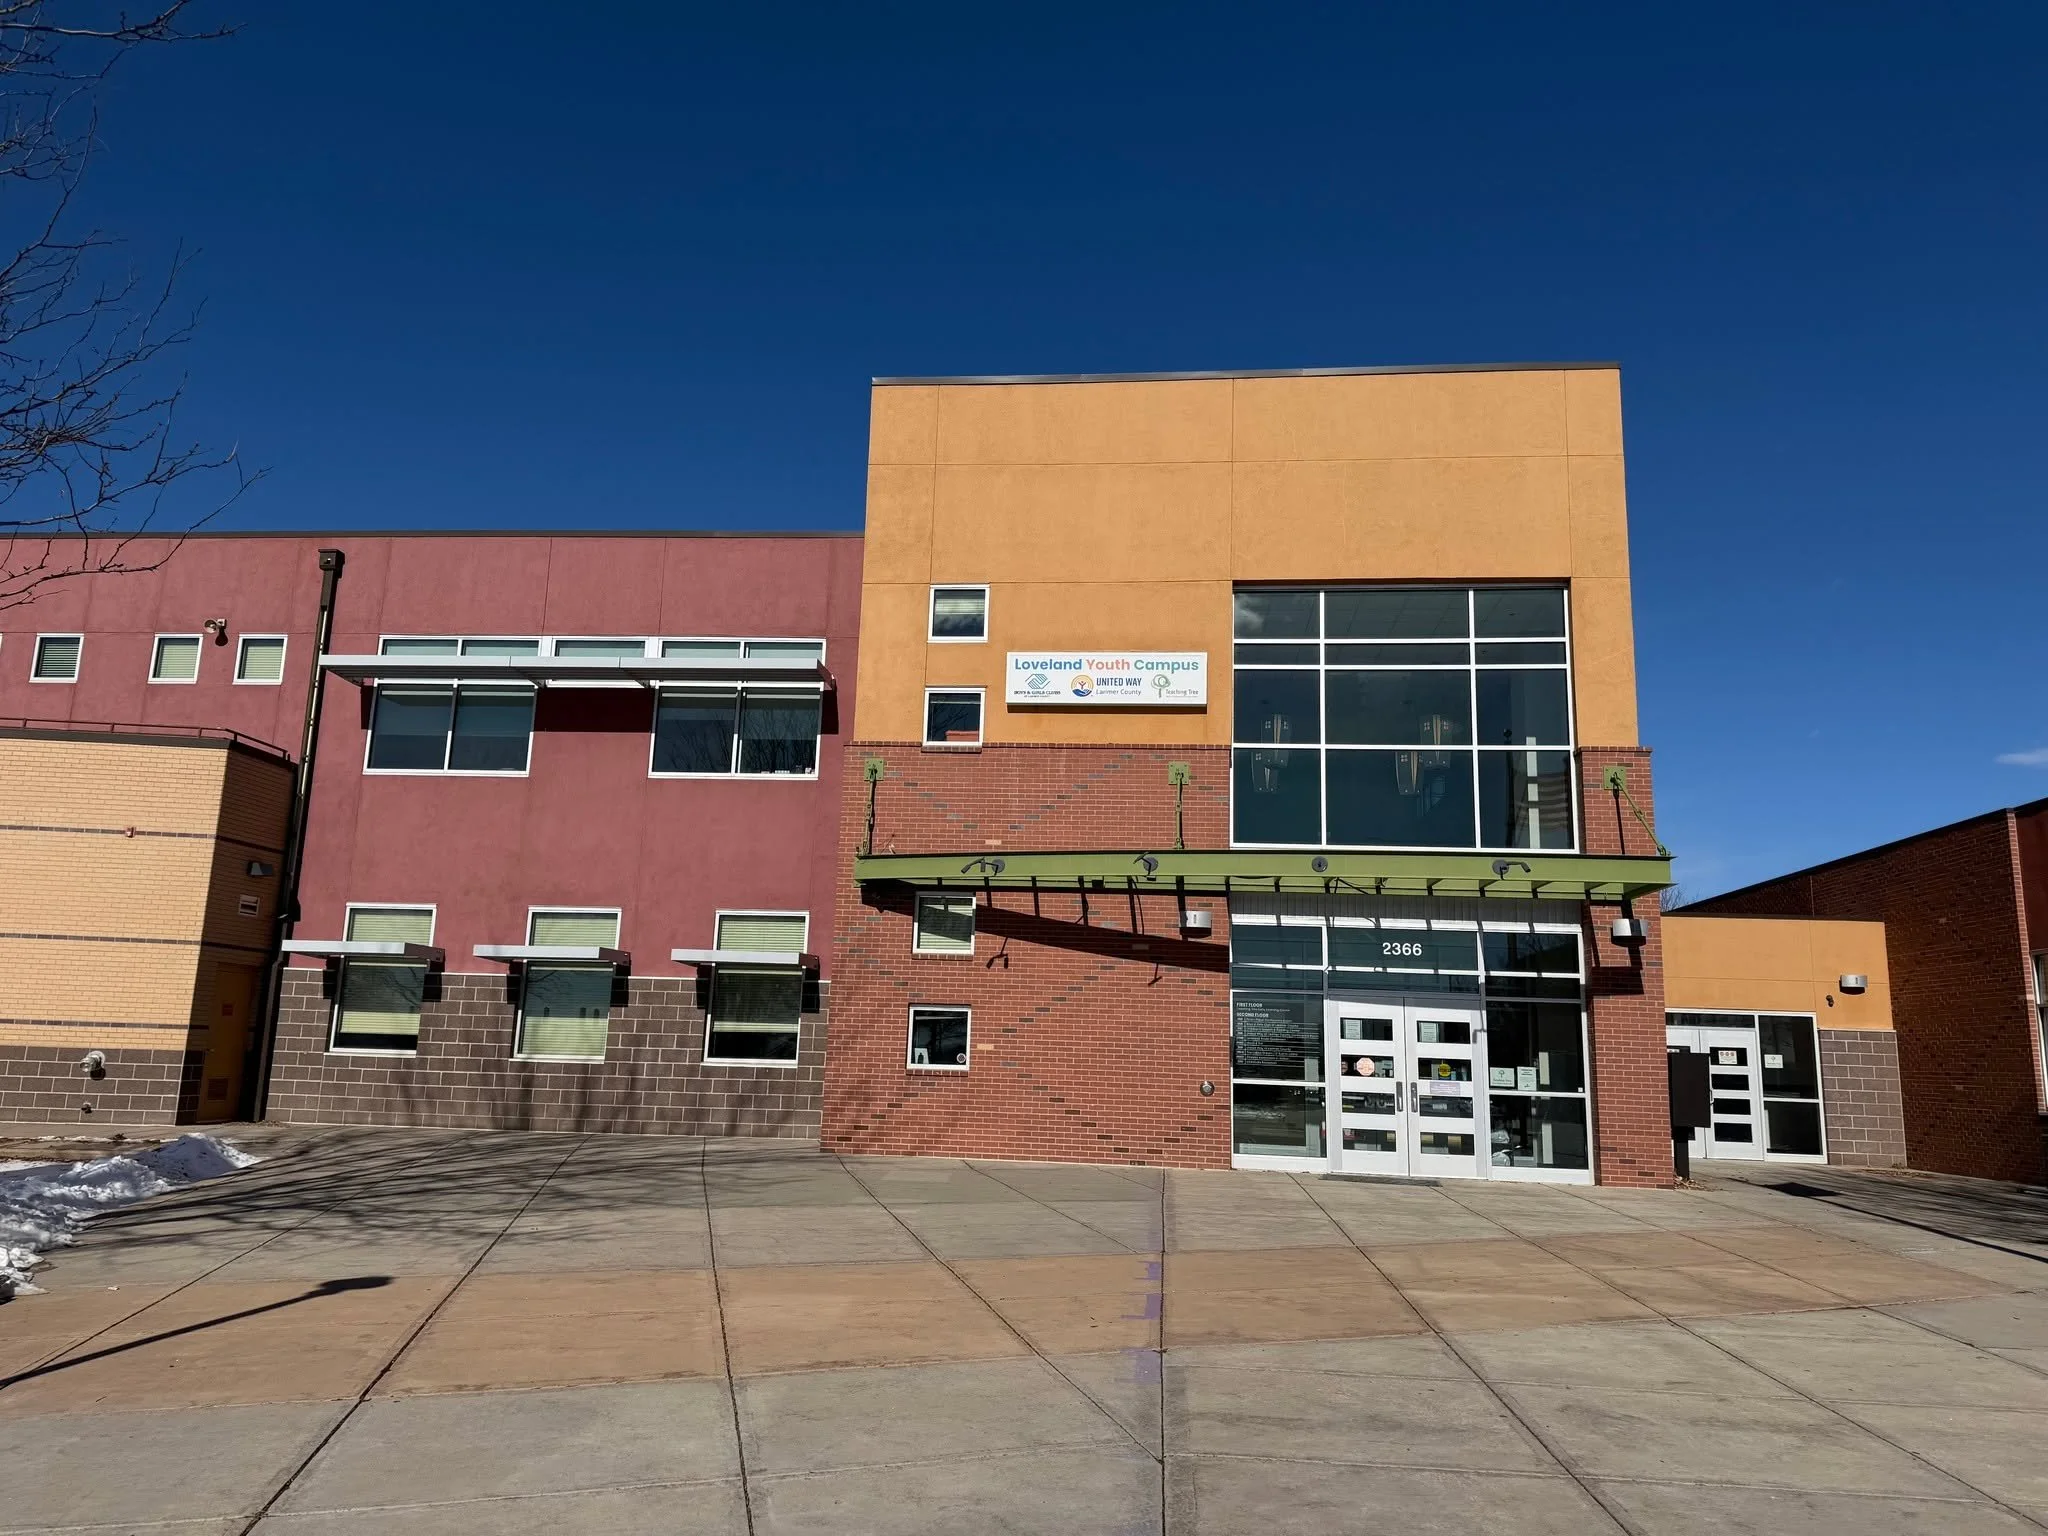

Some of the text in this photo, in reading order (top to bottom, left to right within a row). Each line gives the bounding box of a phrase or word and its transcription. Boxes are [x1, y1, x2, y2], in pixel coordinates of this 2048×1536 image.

[1015, 658, 1199, 674] Loveland Youth Campus
[1096, 677, 1142, 686] UNITED WAY
[1120, 688, 1142, 696] County
[1382, 942, 1422, 956] 2366
